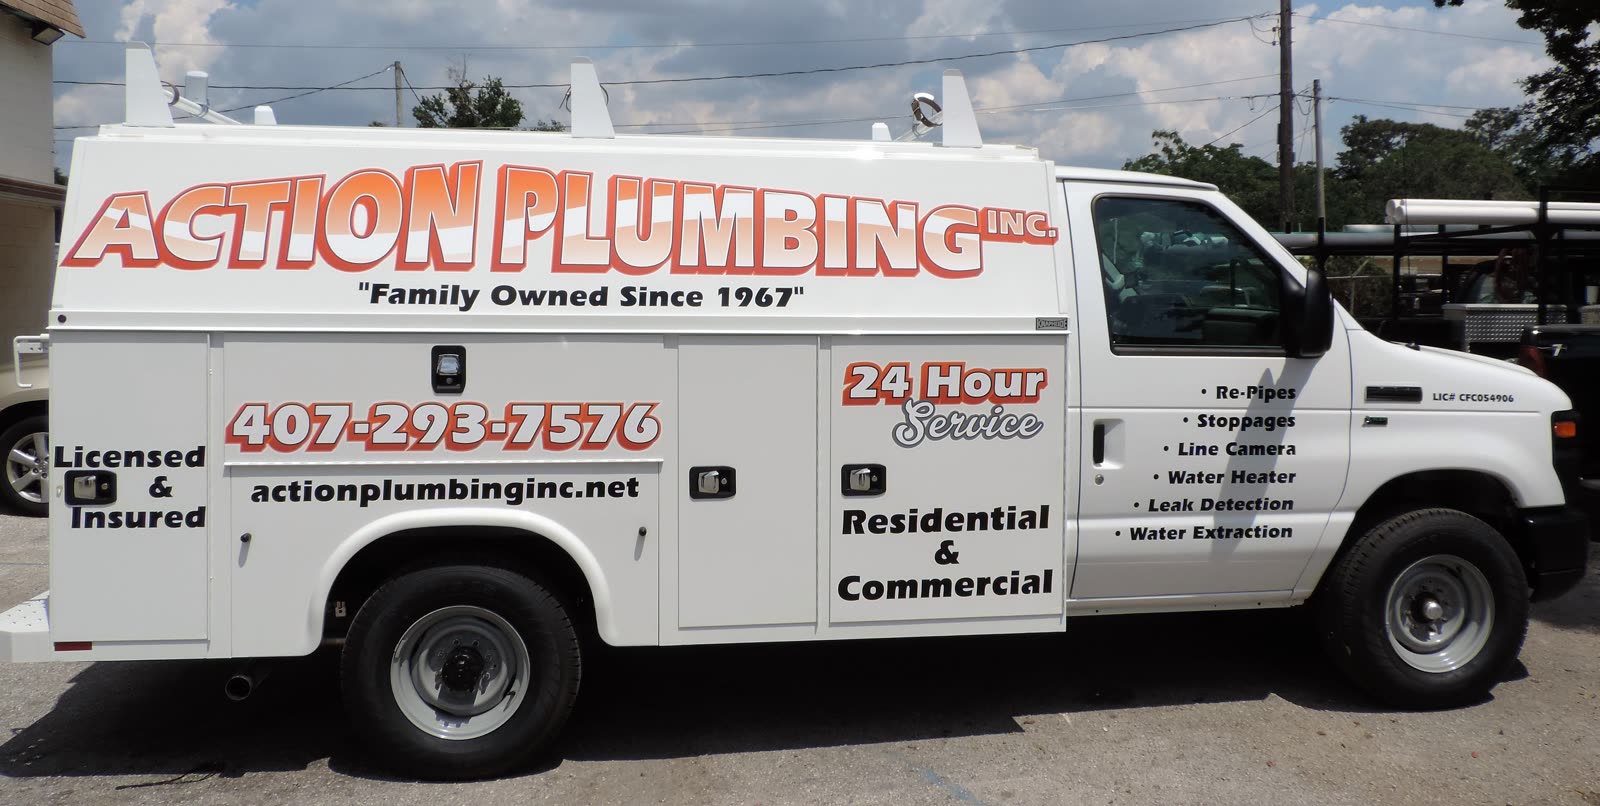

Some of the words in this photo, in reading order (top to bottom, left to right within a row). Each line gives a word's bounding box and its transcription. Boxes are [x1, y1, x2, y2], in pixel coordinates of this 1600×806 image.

[60, 160, 483, 272] ACTION
[491, 165, 983, 279] PLUMBING
[981, 206, 1058, 246] INC.
[359, 282, 480, 312] "Family
[490, 284, 609, 307] Owned
[620, 286, 703, 307] Since
[717, 286, 804, 308] 1967"
[841, 361, 913, 406] 24
[918, 361, 1048, 405] Hour
[1216, 385, 1297, 402] Re-Pipes
[1432, 392, 1456, 402] LIC#
[1459, 393, 1515, 403] CFC054906
[224, 402, 662, 453] 407-293-7576
[892, 397, 1044, 448] Service
[1197, 413, 1297, 432] Stoppages
[54, 445, 206, 468] Licensed
[1178, 442, 1219, 456] Line
[1225, 441, 1297, 457] Camera
[148, 475, 174, 499] &
[1168, 470, 1225, 485] Water
[1230, 469, 1297, 485] Heater
[250, 477, 640, 508] actionplumbinginc.net
[71, 505, 207, 529] Insured
[1148, 498, 1195, 513] Leak
[1199, 497, 1294, 512] Detection
[842, 504, 1050, 535] Residential
[1129, 527, 1187, 541] Water
[1192, 525, 1294, 541] Extraction
[934, 539, 960, 566] &
[837, 568, 1053, 602] Commercial
